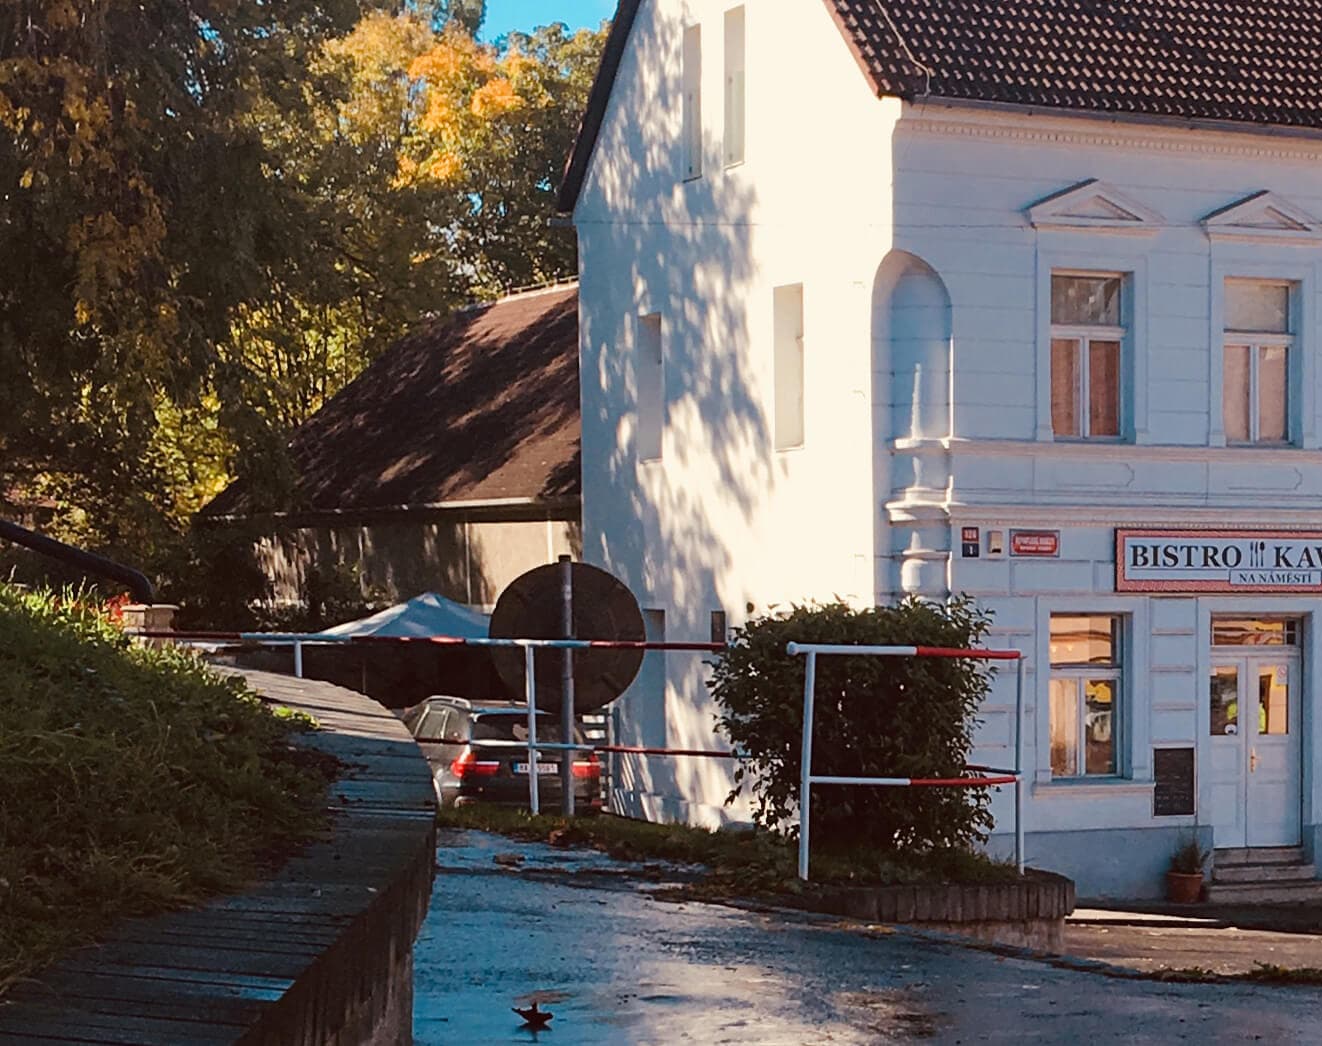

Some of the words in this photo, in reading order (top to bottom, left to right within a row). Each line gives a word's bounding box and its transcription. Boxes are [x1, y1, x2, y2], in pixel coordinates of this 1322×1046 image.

[1130, 544, 1242, 568] BISTRO
[1239, 573, 1256, 583] NA
[1259, 570, 1312, 583] NÁMĚSTÍ
